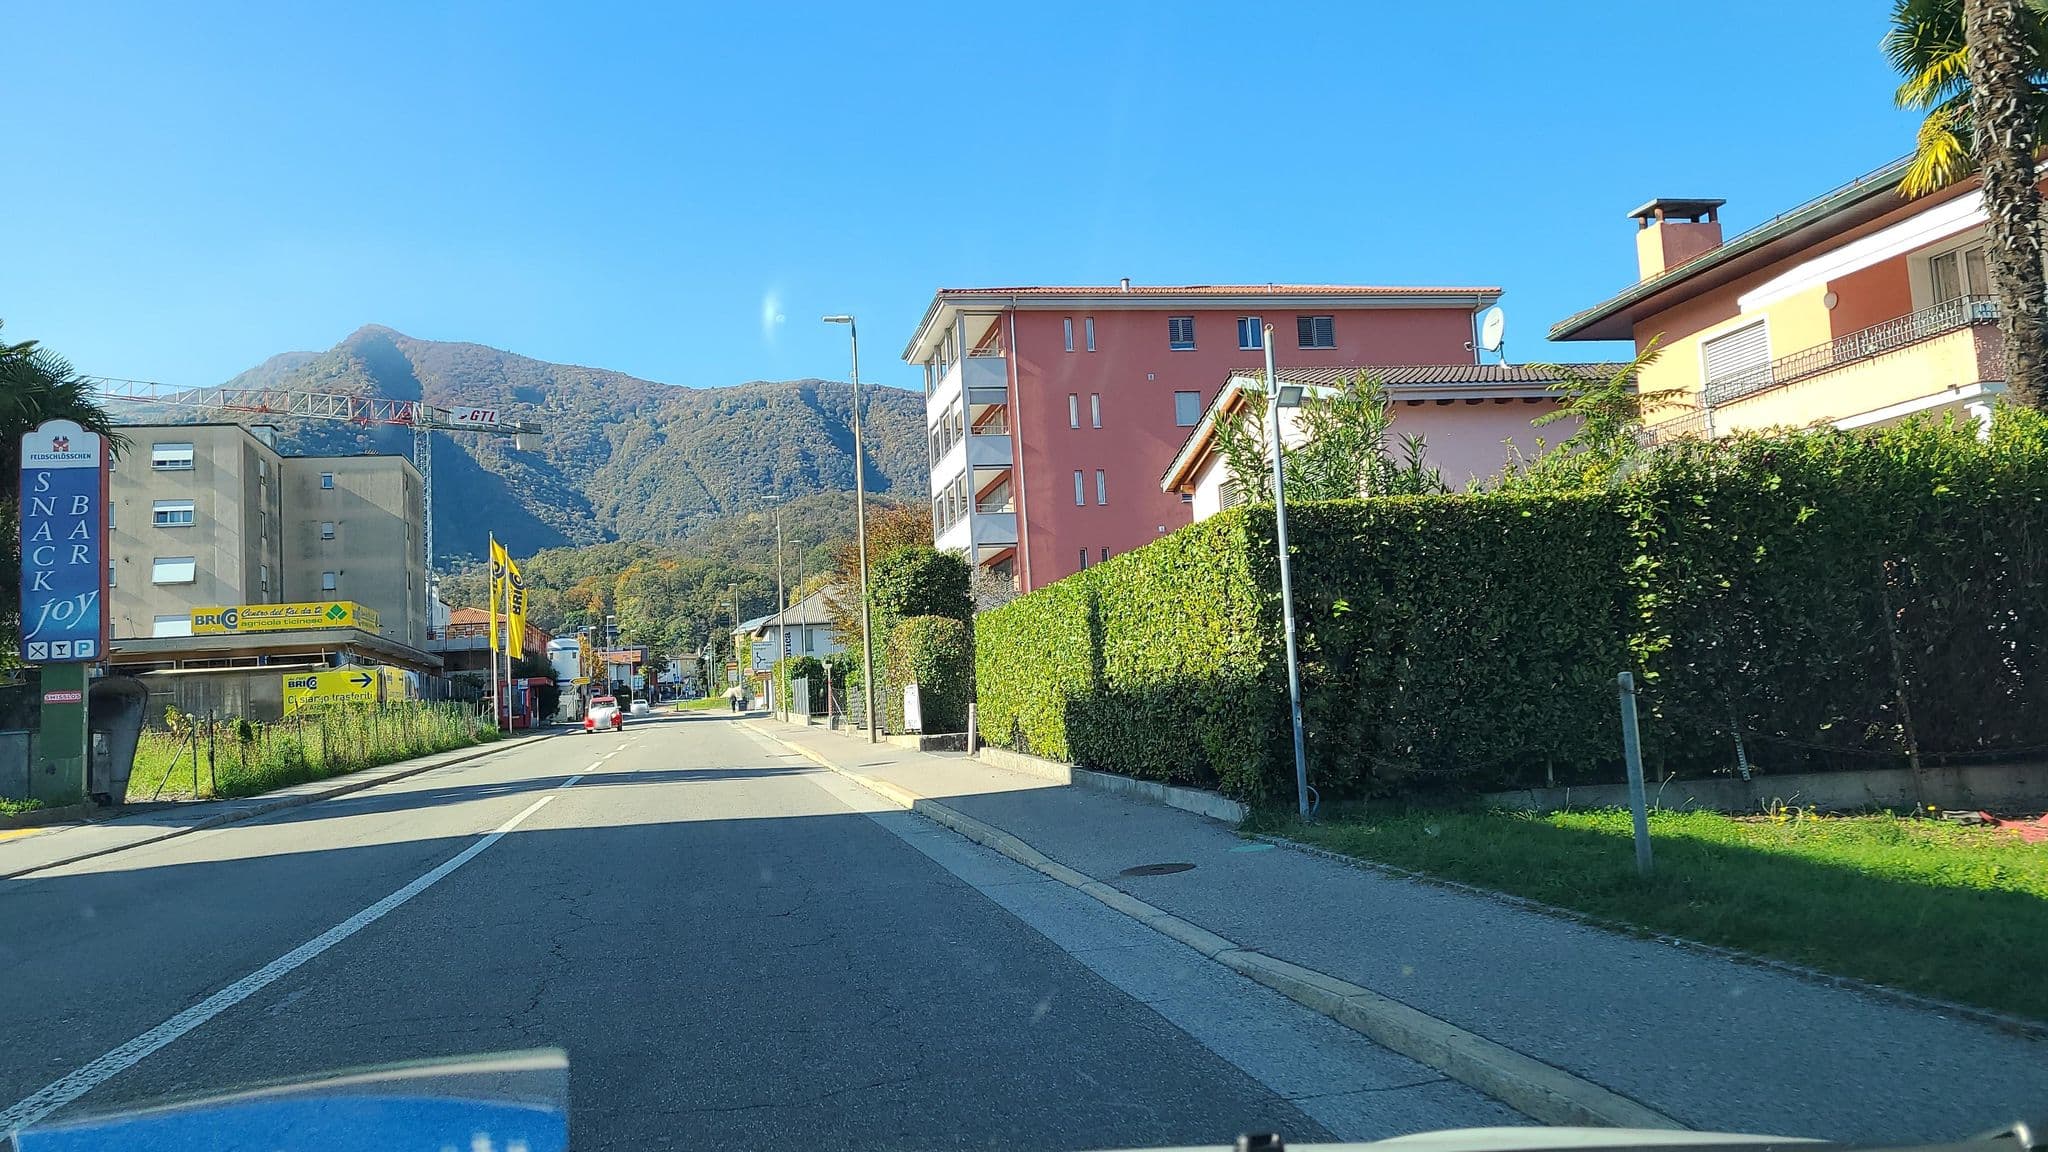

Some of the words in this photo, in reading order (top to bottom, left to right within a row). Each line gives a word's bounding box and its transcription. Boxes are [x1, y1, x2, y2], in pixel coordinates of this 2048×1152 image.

[470, 409, 495, 422] GTL
[30, 452, 92, 460] FELDSCHLÖSSCHEN
[29, 471, 58, 592] SNACK
[68, 495, 91, 565] BAR
[24, 589, 100, 641] joy
[194, 608, 238, 630] BRICO
[241, 620, 281, 628] agricola
[284, 617, 323, 625] ticinese
[288, 676, 317, 690] BRICO
